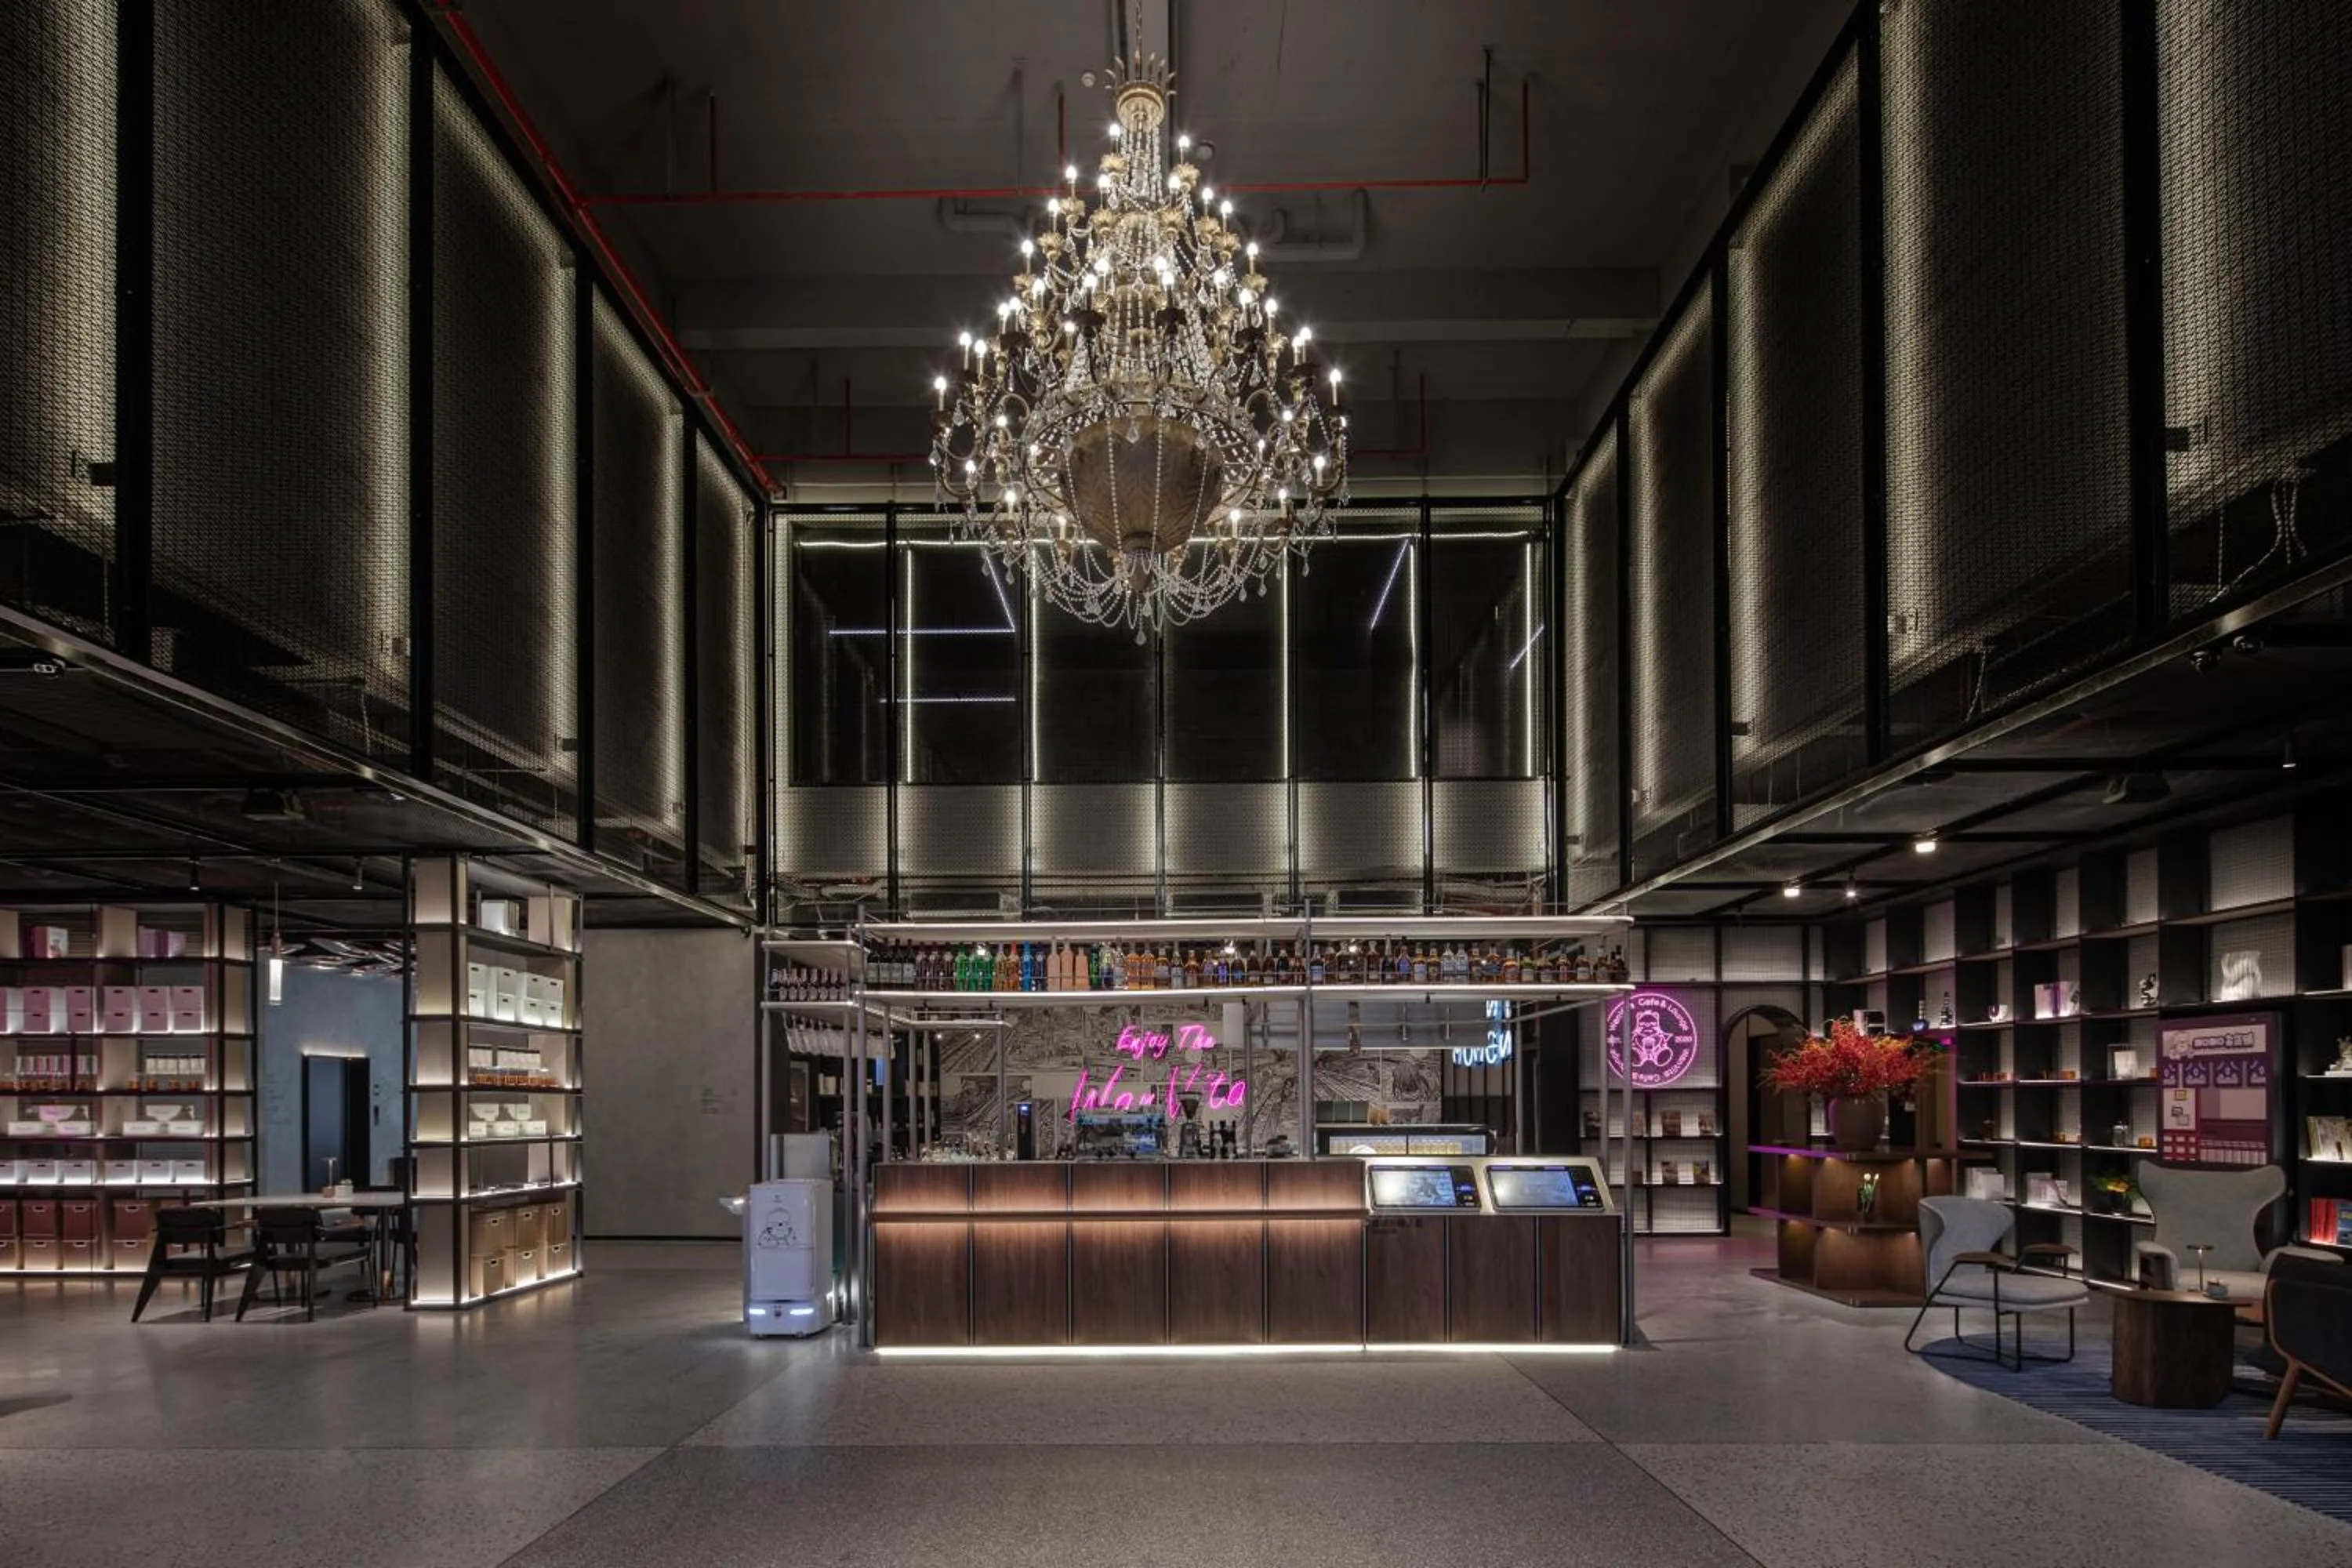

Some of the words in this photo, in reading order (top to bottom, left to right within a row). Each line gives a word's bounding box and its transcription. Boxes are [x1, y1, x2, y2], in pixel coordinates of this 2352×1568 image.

[1116, 1024, 1170, 1059] Enjoy
[1178, 1024, 1215, 1051] The
[1166, 1062, 1247, 1122] Vta
